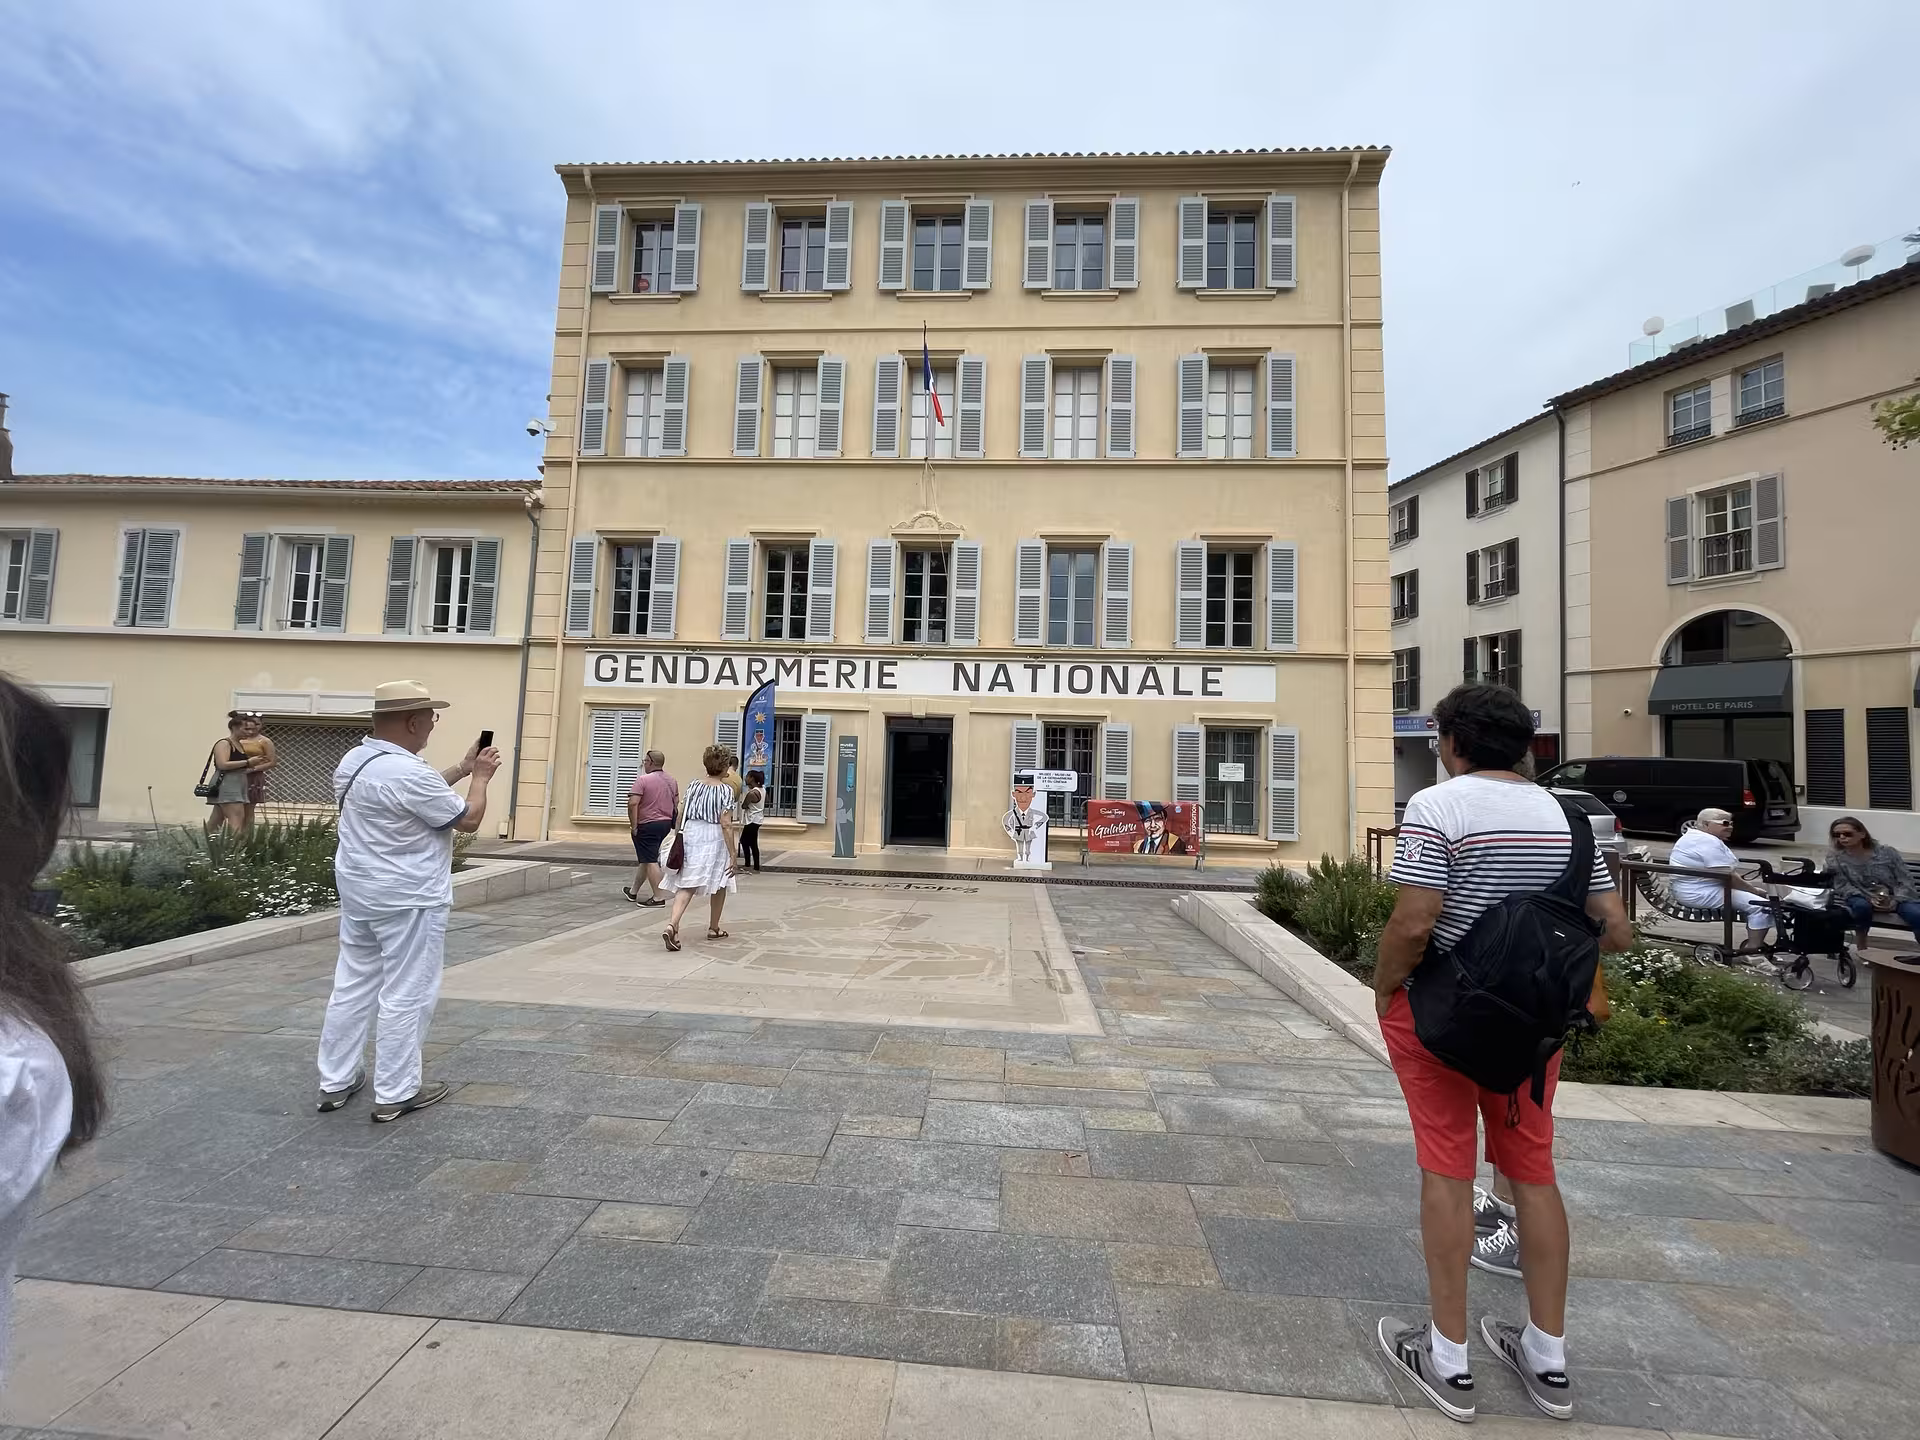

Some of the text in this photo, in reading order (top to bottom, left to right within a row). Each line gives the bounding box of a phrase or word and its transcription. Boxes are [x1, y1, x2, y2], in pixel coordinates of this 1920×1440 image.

[594, 654, 1223, 697] GENDARMERIE NATIONALE
[1671, 701, 1754, 711] HOTEL DE PARIS
[1095, 822, 1137, 839] Galabru
